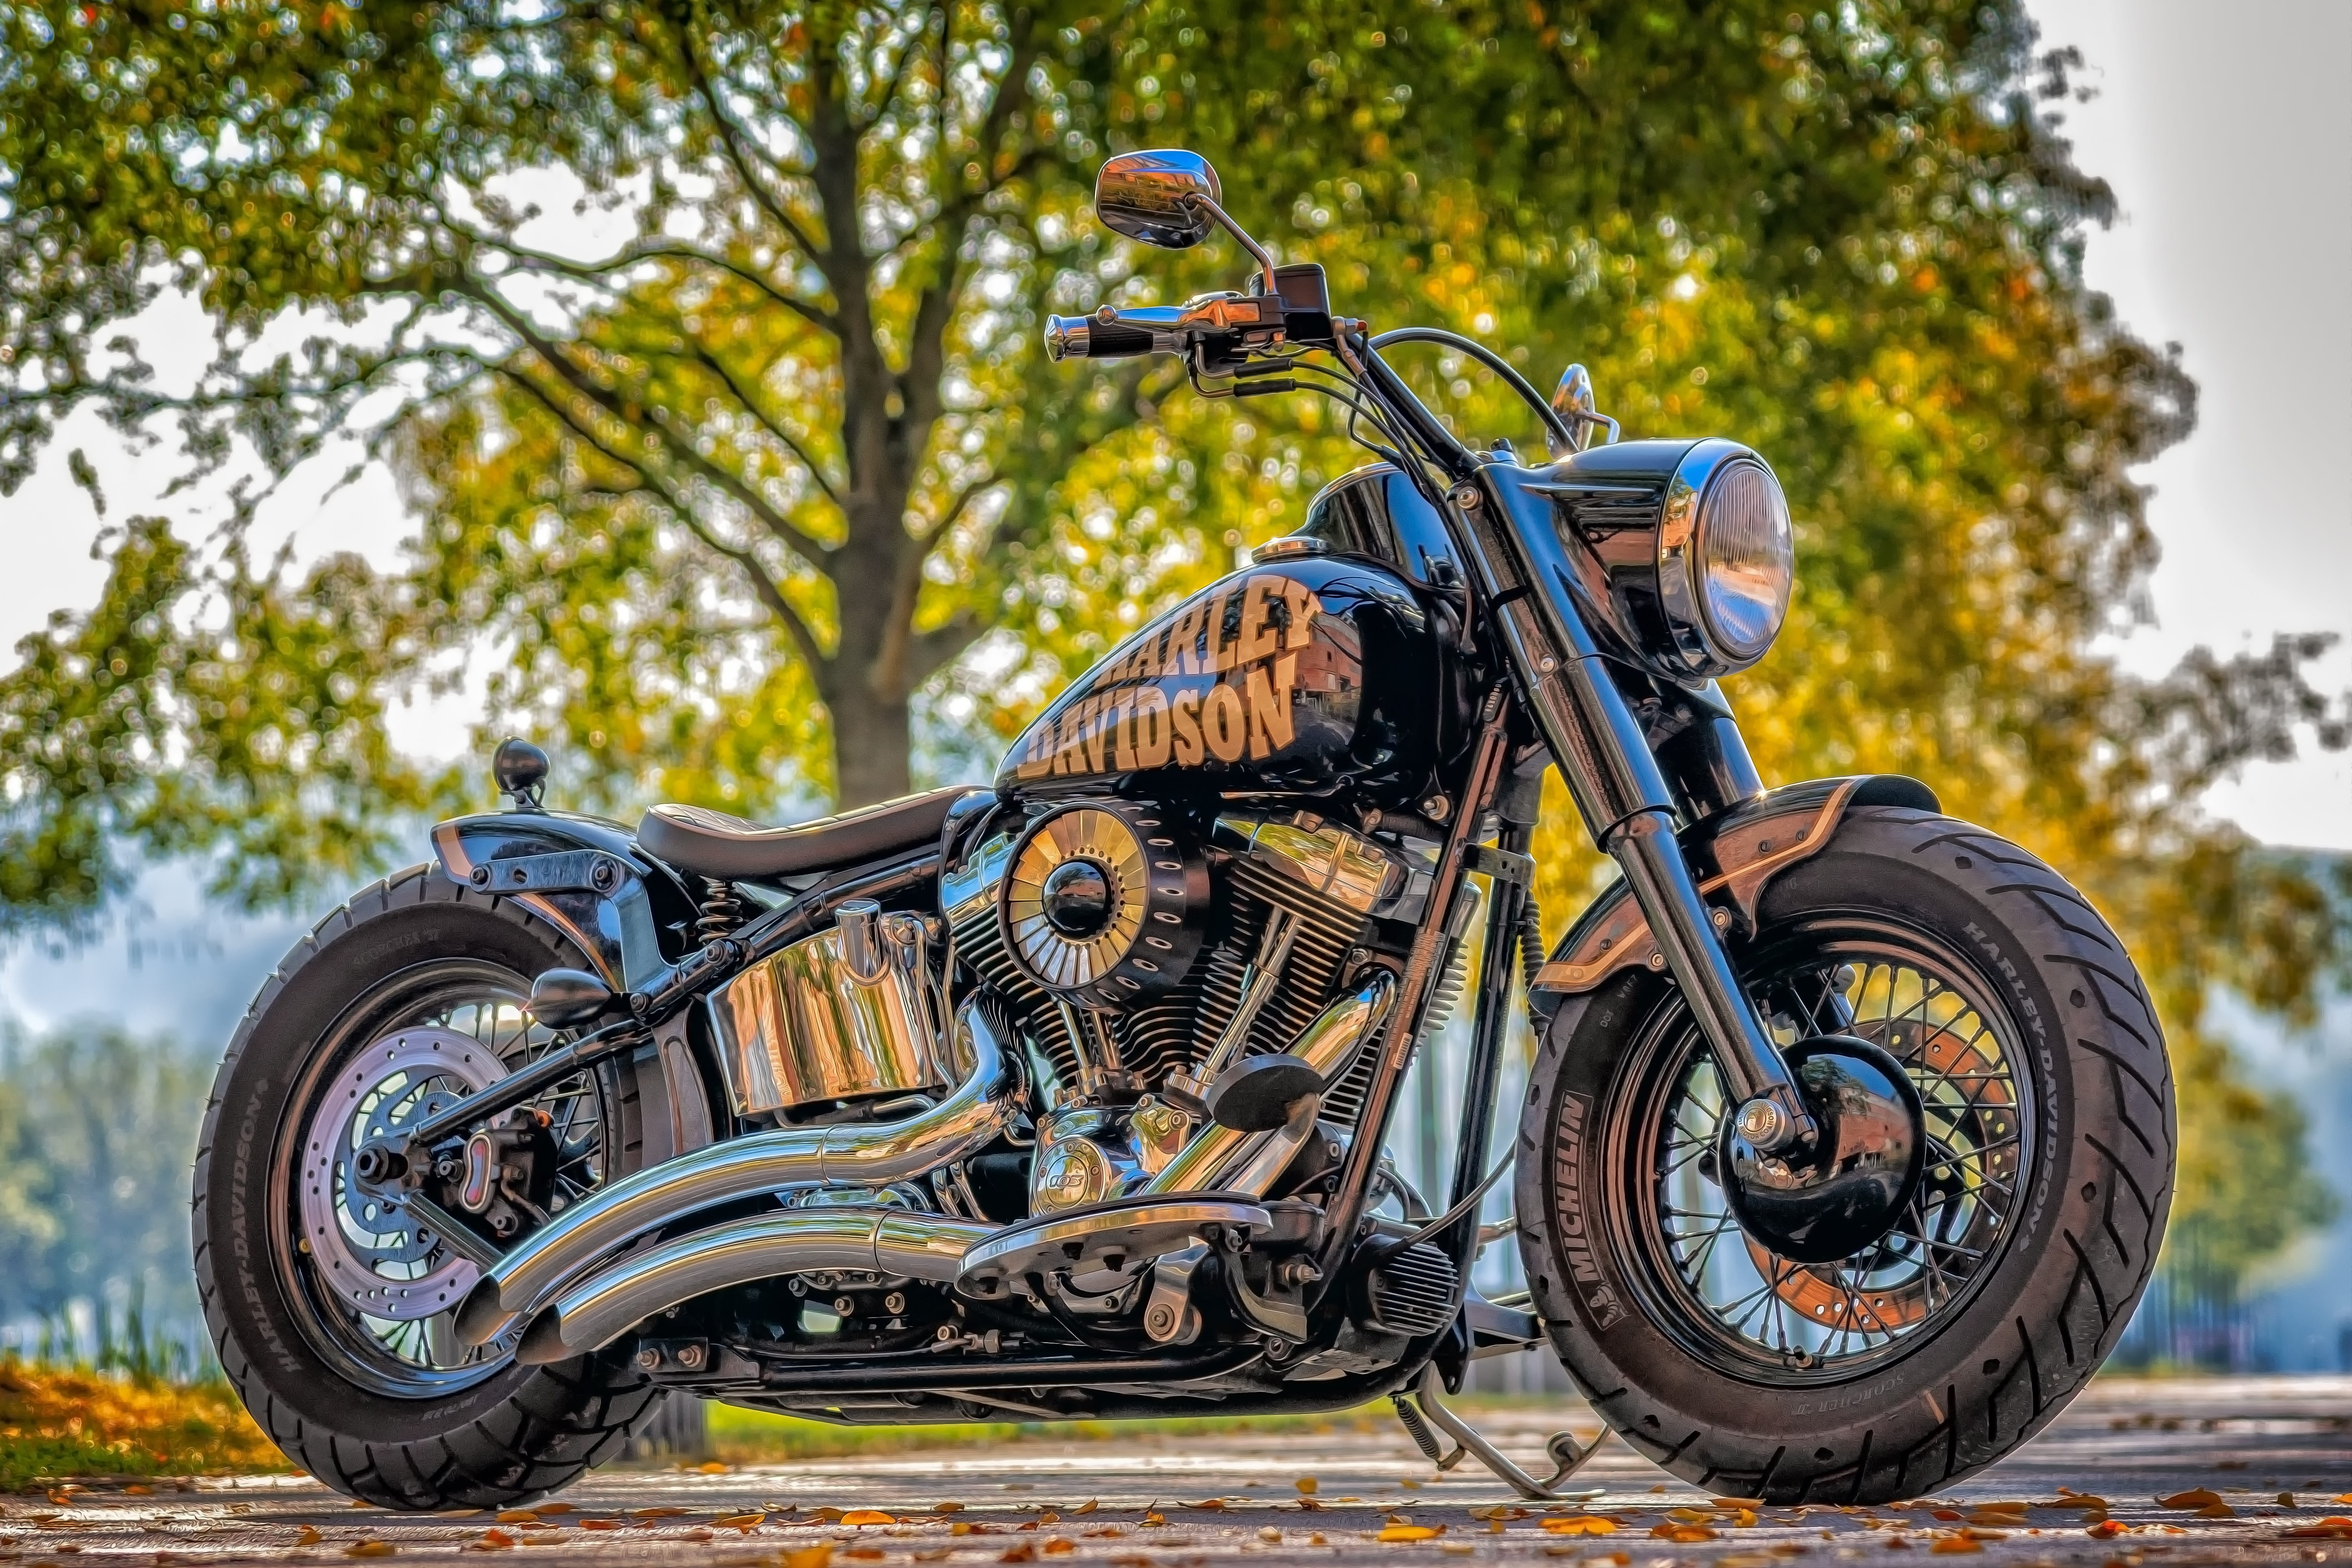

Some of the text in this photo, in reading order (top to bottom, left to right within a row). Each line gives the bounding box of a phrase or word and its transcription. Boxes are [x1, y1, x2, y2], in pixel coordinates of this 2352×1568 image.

[1017, 651, 1297, 779] DAVIDSON
[1049, 1174, 1084, 1188] 103
[1556, 1095, 1600, 1281] MICHELIN
